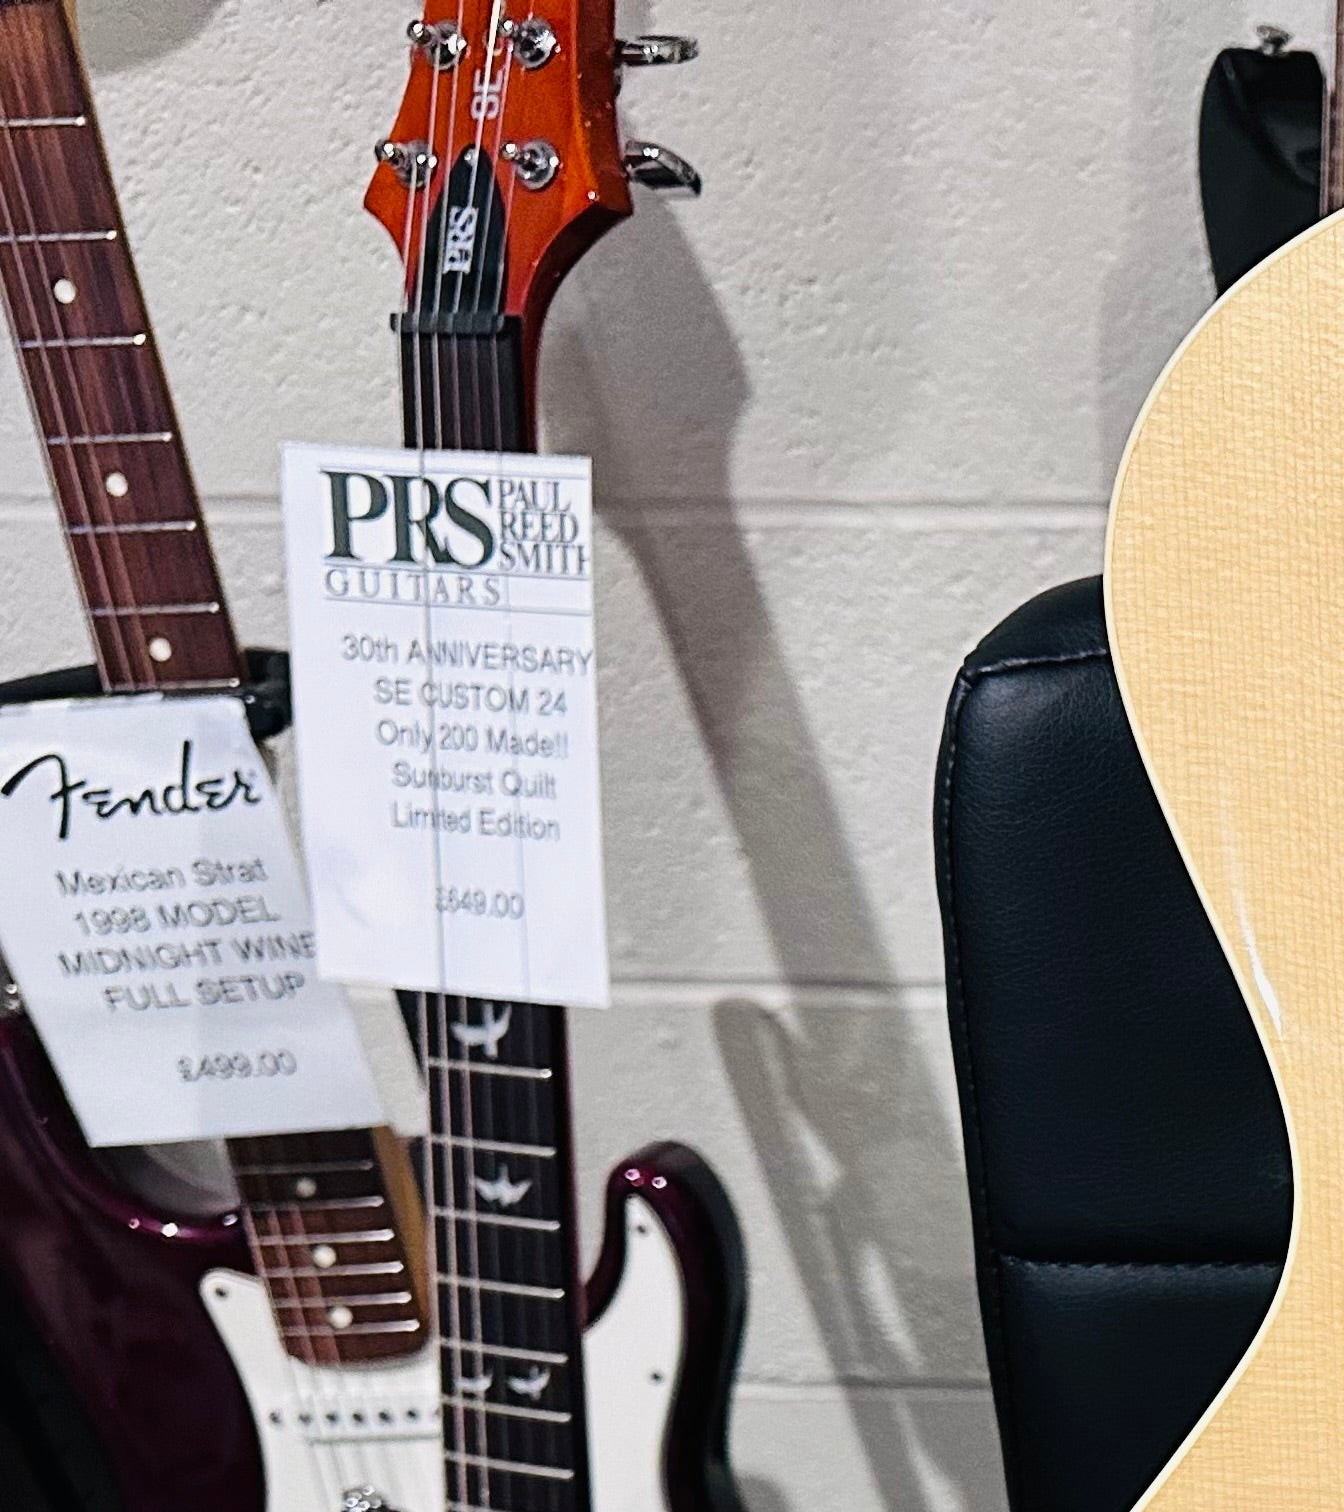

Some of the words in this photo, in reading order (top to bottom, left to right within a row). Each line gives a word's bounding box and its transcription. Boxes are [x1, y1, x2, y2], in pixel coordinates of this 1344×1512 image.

[443, 204, 479, 274] PRS
[498, 478, 572, 512] PAUL
[320, 471, 494, 569] PRS
[498, 511, 580, 544] REED
[324, 568, 501, 607] GUITARS
[341, 634, 399, 664] 30th
[406, 638, 594, 676] ANNIVERSARY
[374, 678, 413, 706] SE
[421, 682, 530, 715] CUSTOM
[537, 690, 568, 717] 24
[376, 718, 433, 753] Only
[438, 724, 479, 752] 200
[486, 728, 569, 759] Made!!
[1, 740, 261, 839] Fender
[391, 761, 493, 796] Sunburst
[501, 770, 557, 800] Quilt
[391, 800, 471, 833] Limited
[478, 807, 561, 842] Edition
[55, 864, 187, 898] Mexican
[192, 856, 269, 888] Strat
[72, 908, 151, 938] 1998
[157, 895, 281, 931] MODEL
[56, 938, 225, 978] MIDNIGHT
[230, 930, 317, 962] WINE
[104, 982, 194, 1013] FULL
[195, 971, 306, 1005] SETUP
[176, 1048, 298, 1084] £499.00
